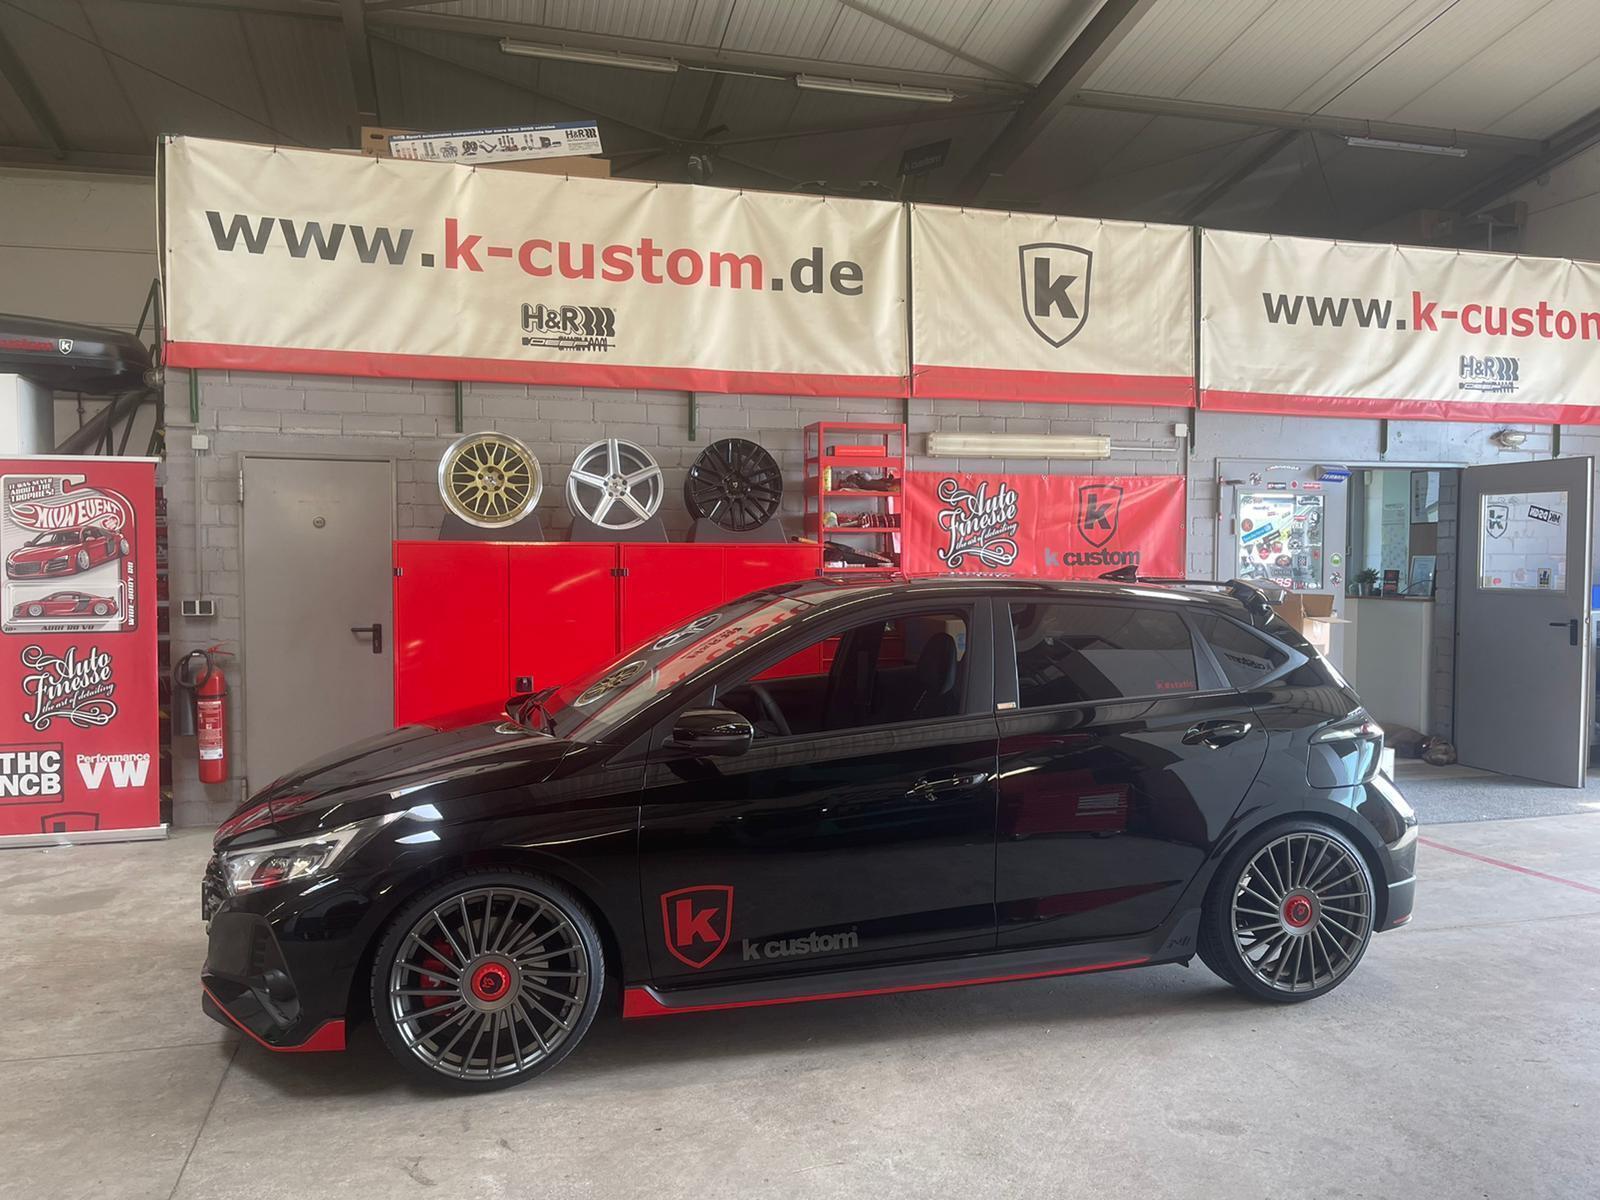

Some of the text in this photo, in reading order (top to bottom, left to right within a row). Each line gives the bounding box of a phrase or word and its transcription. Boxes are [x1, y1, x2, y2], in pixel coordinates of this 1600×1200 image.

[565, 129, 585, 139] H&R
[205, 211, 864, 296] www.k-custom.de
[521, 303, 585, 335] H&R
[1460, 355, 1496, 380] H&R
[11, 485, 35, 495] ABOUT
[938, 479, 1017, 519] Auto
[938, 502, 1017, 559] Finesse
[1045, 547, 1141, 567] k custom
[22, 646, 111, 684] Auto
[24, 665, 111, 723] Finesse
[77, 683, 114, 701] detailing
[0, 751, 61, 774] THC
[77, 753, 150, 763] Performance
[0, 773, 61, 797] NCB
[78, 761, 150, 789] VW
[742, 930, 858, 961] k custom
